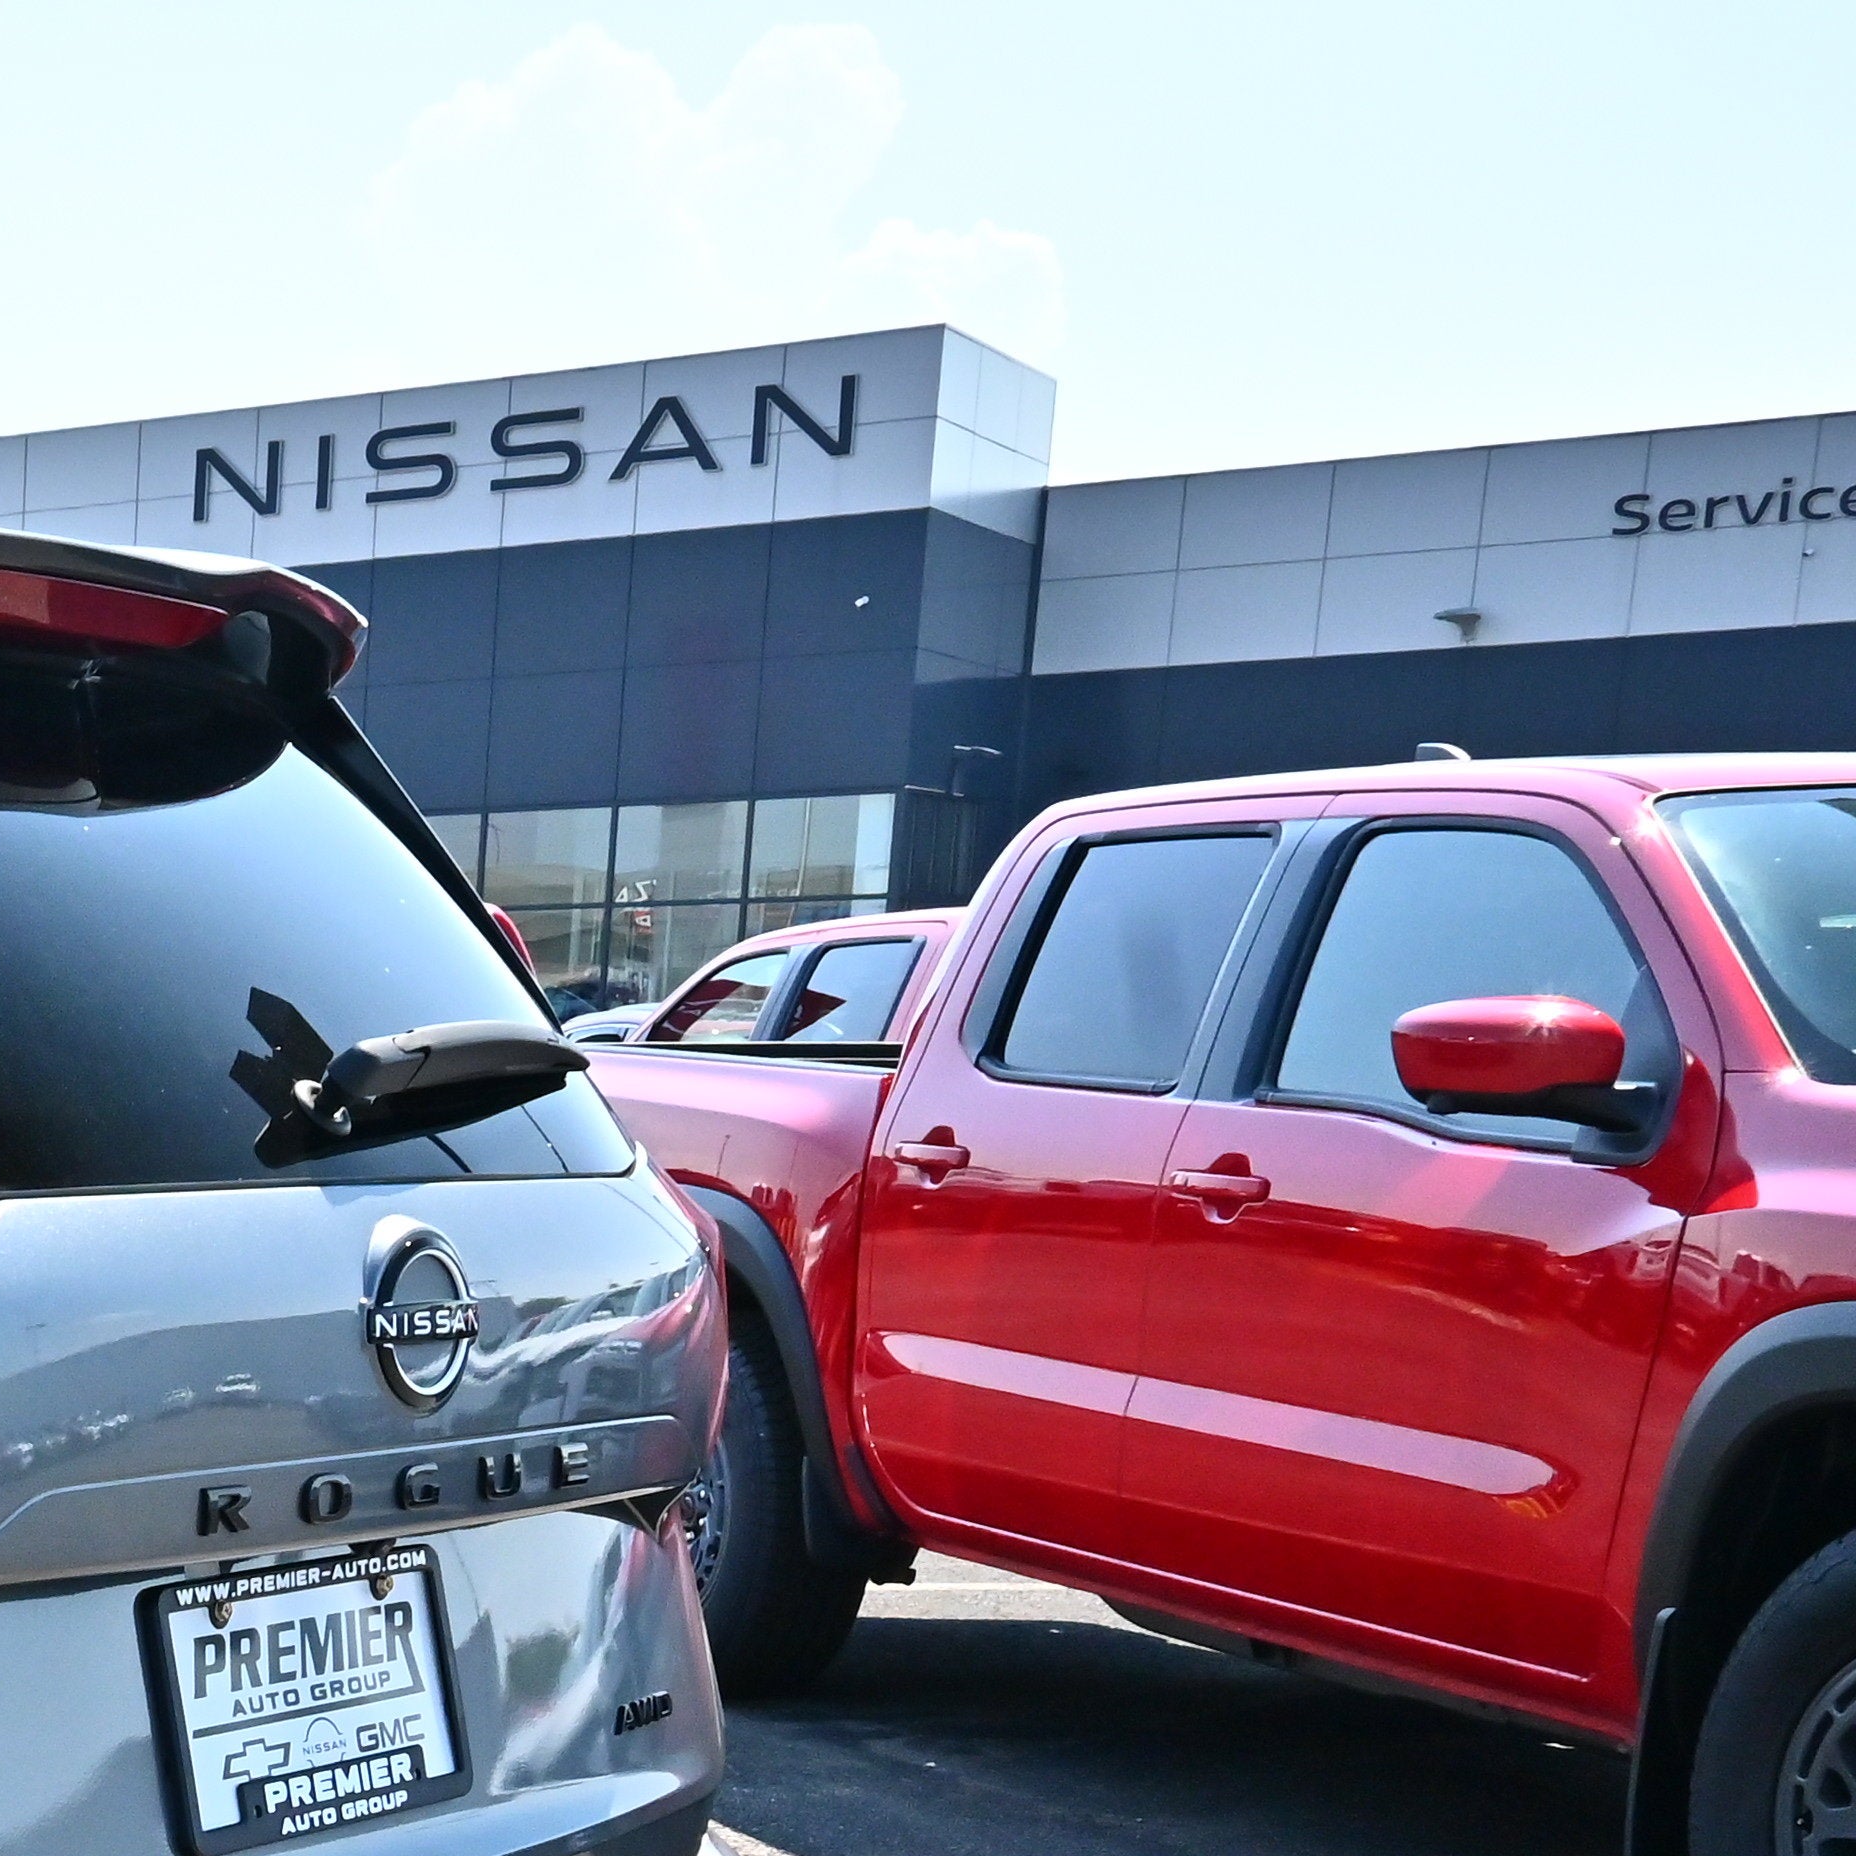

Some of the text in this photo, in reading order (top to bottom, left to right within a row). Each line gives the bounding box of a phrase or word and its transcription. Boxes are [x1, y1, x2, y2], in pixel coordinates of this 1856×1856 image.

[192, 374, 860, 523] NISSAN
[374, 1307, 479, 1338] NISSAN
[195, 1441, 591, 1537] ROGUE
[175, 1549, 427, 1606] WWW.PREMIER-AUTO.COM
[192, 1600, 423, 1699] PREMIER
[232, 1670, 391, 1718] AUTO GROUP
[613, 1690, 673, 1736] AWD
[301, 1738, 348, 1756] NISSAN
[355, 1713, 426, 1752] GMC
[263, 1752, 414, 1815] PREMIER
[280, 1789, 409, 1836] AUTO GROUP
